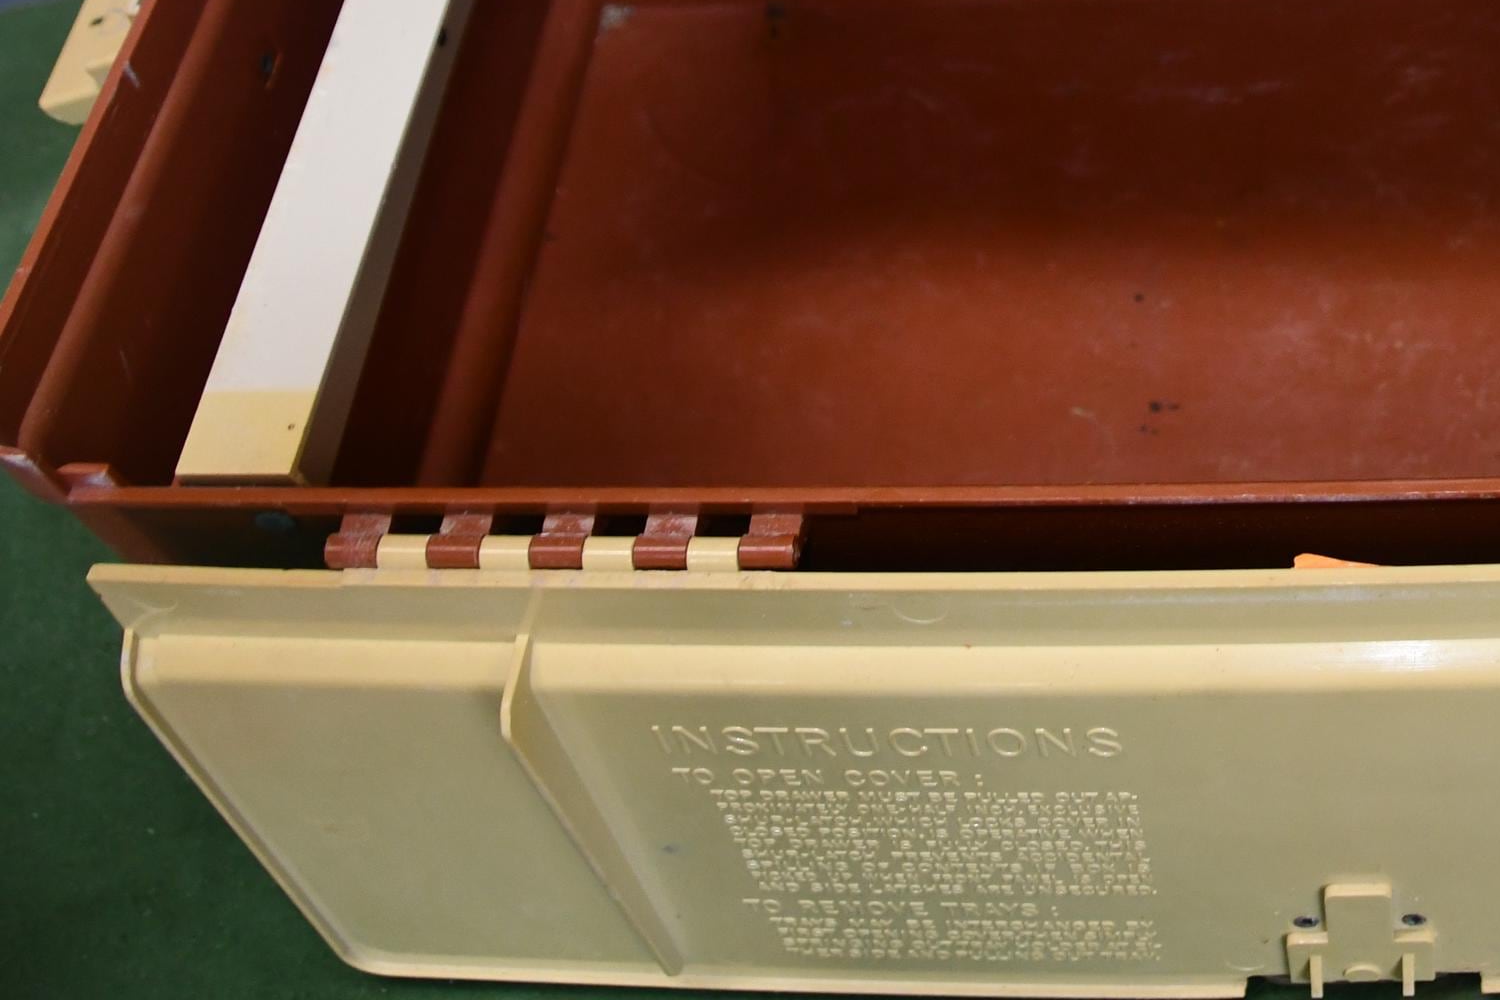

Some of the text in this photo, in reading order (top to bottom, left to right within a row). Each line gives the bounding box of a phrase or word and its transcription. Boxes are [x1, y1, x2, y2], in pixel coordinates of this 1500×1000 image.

[651, 724, 1123, 759] INSTRUCTIONS
[672, 767, 714, 785] TO
[732, 768, 824, 787] OPEN
